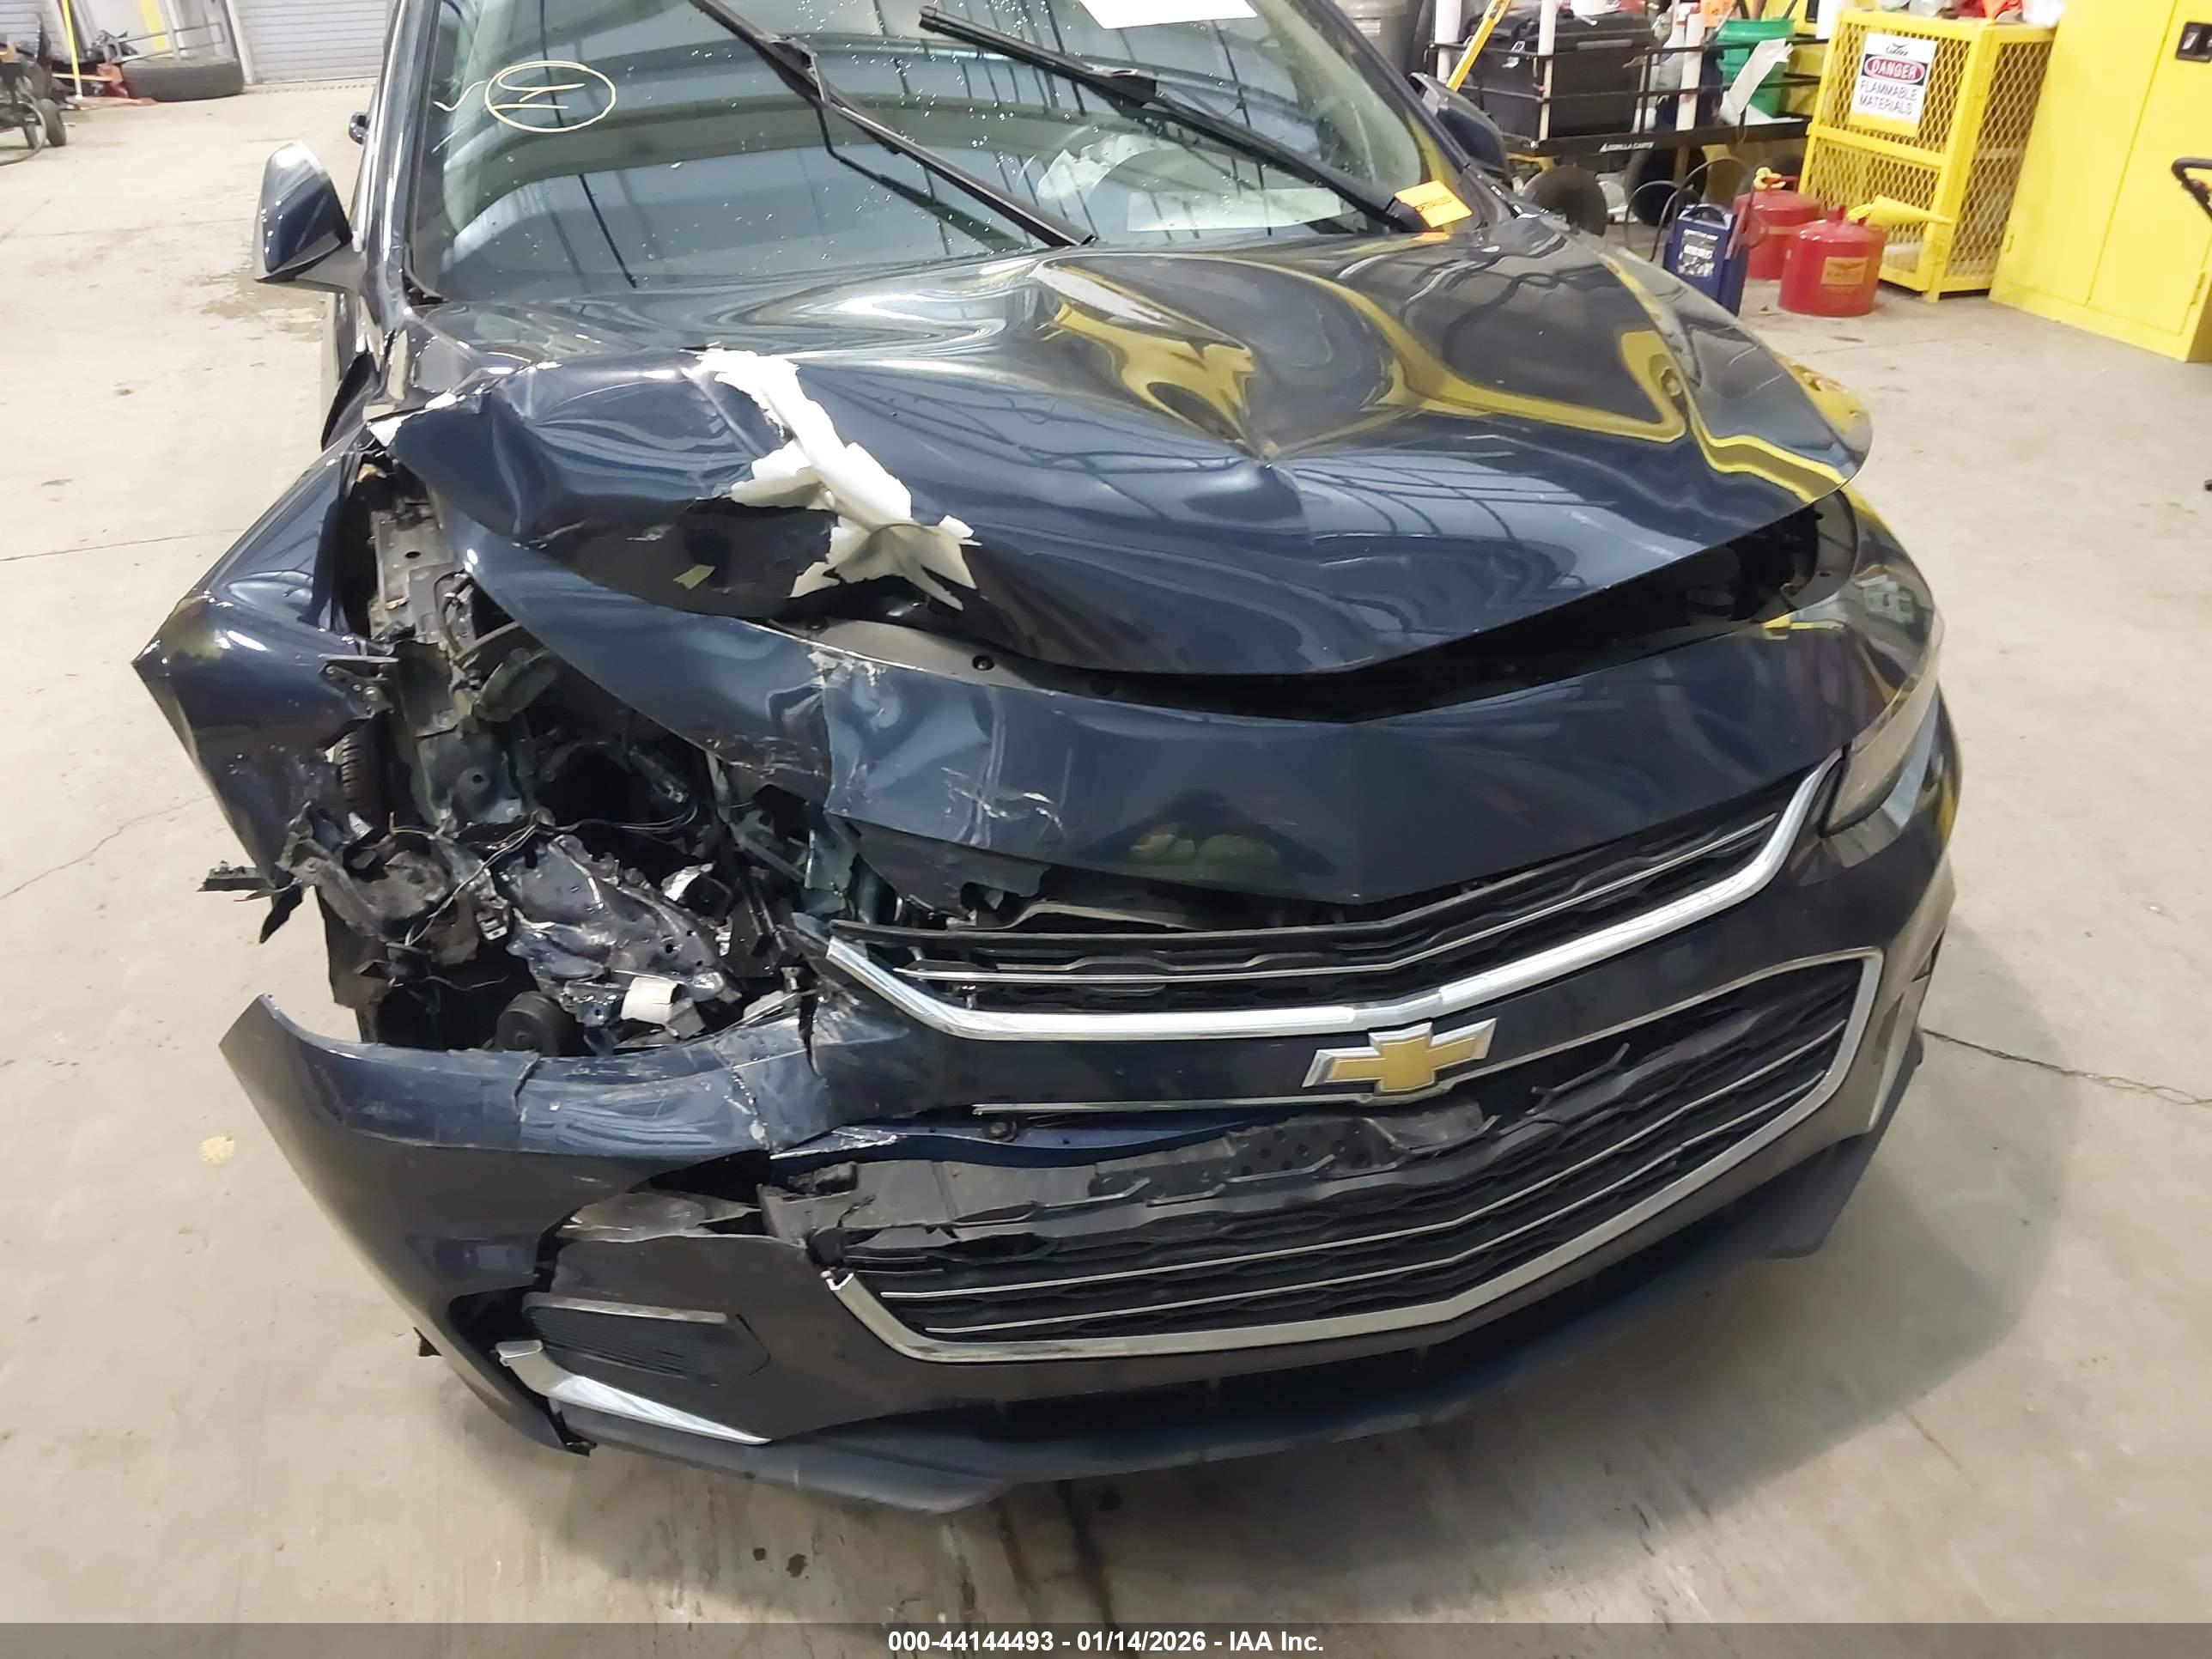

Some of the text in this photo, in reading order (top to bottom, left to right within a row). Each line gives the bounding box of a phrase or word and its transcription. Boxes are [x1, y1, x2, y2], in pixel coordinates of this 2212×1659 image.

[1871, 58, 1917, 80] DANGER
[1860, 79, 1918, 101] FLAMMABLE
[1859, 94, 1913, 116] MATERIALS
